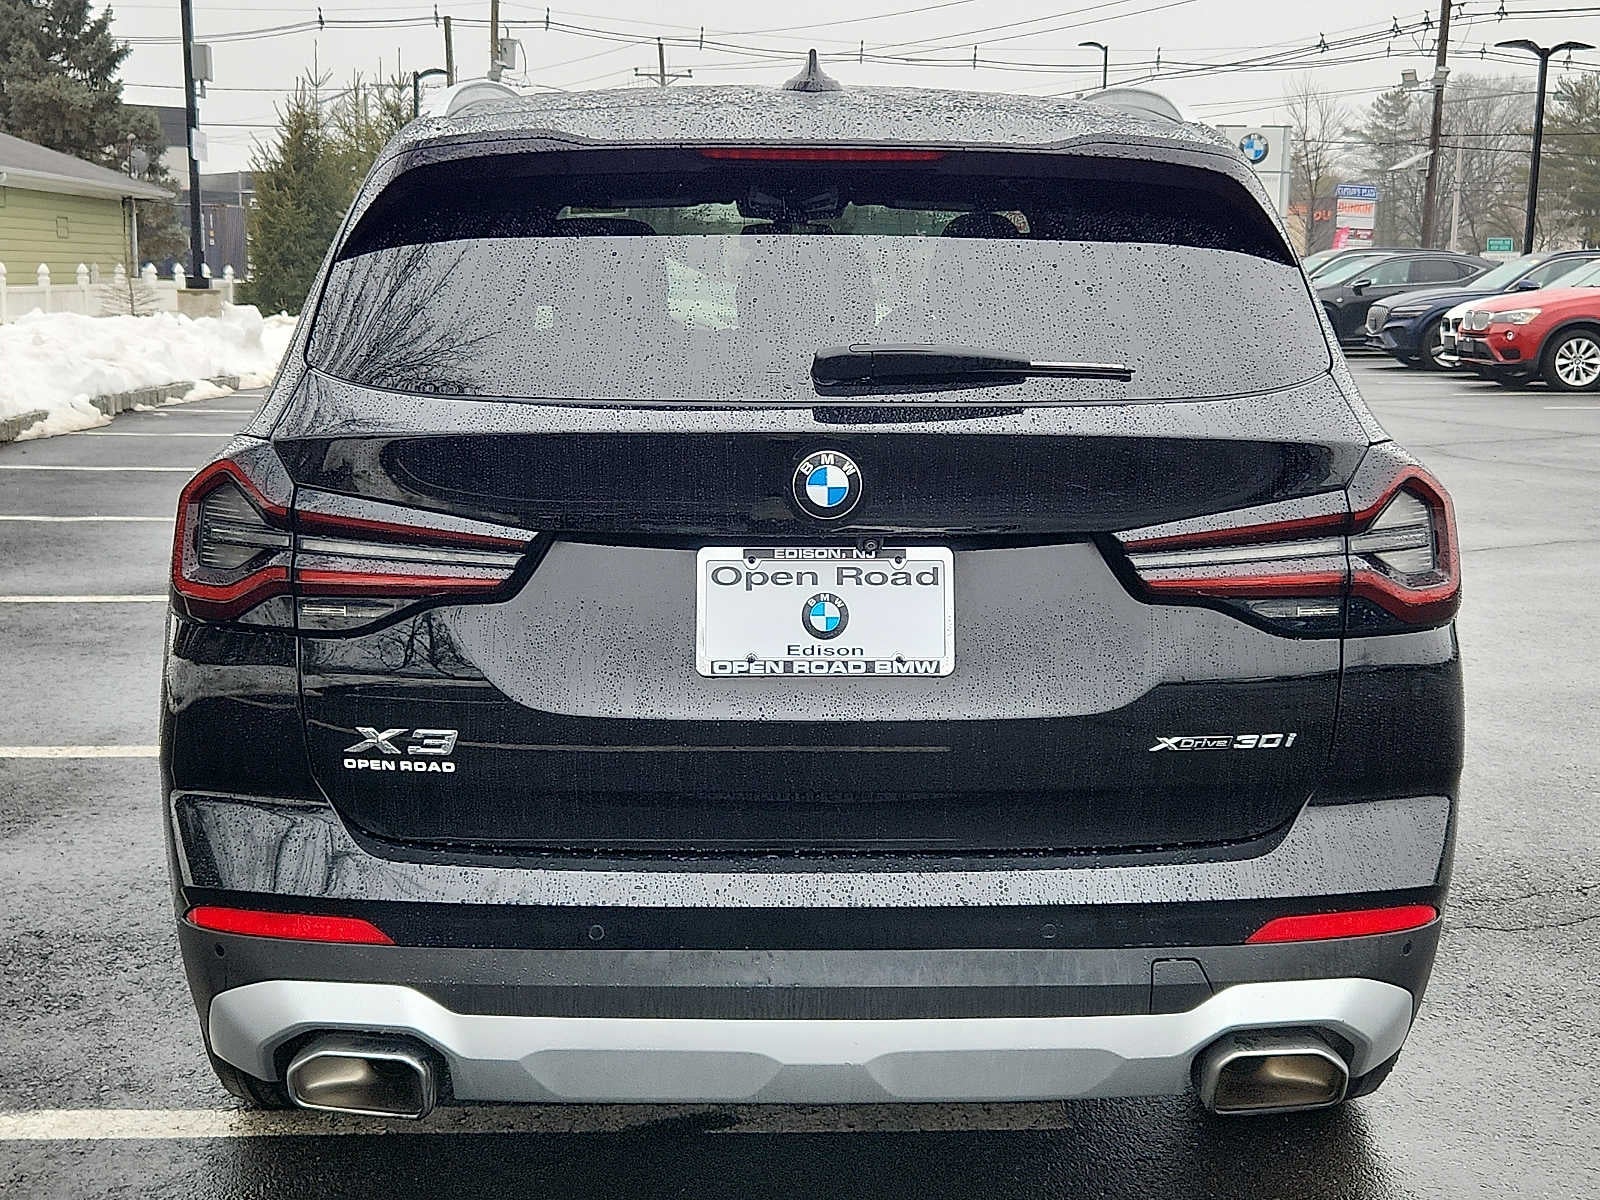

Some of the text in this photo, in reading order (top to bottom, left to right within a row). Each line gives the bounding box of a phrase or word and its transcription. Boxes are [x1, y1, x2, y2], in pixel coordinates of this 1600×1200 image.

[800, 454, 857, 476] BMW
[852, 549, 876, 559] NJ
[711, 566, 939, 591] Open Road
[807, 593, 844, 608] BMW
[787, 644, 864, 656] Edison
[712, 660, 939, 674] OPEN ROAD BMW
[344, 726, 458, 755] X3
[343, 758, 456, 773] OPEN ROAD
